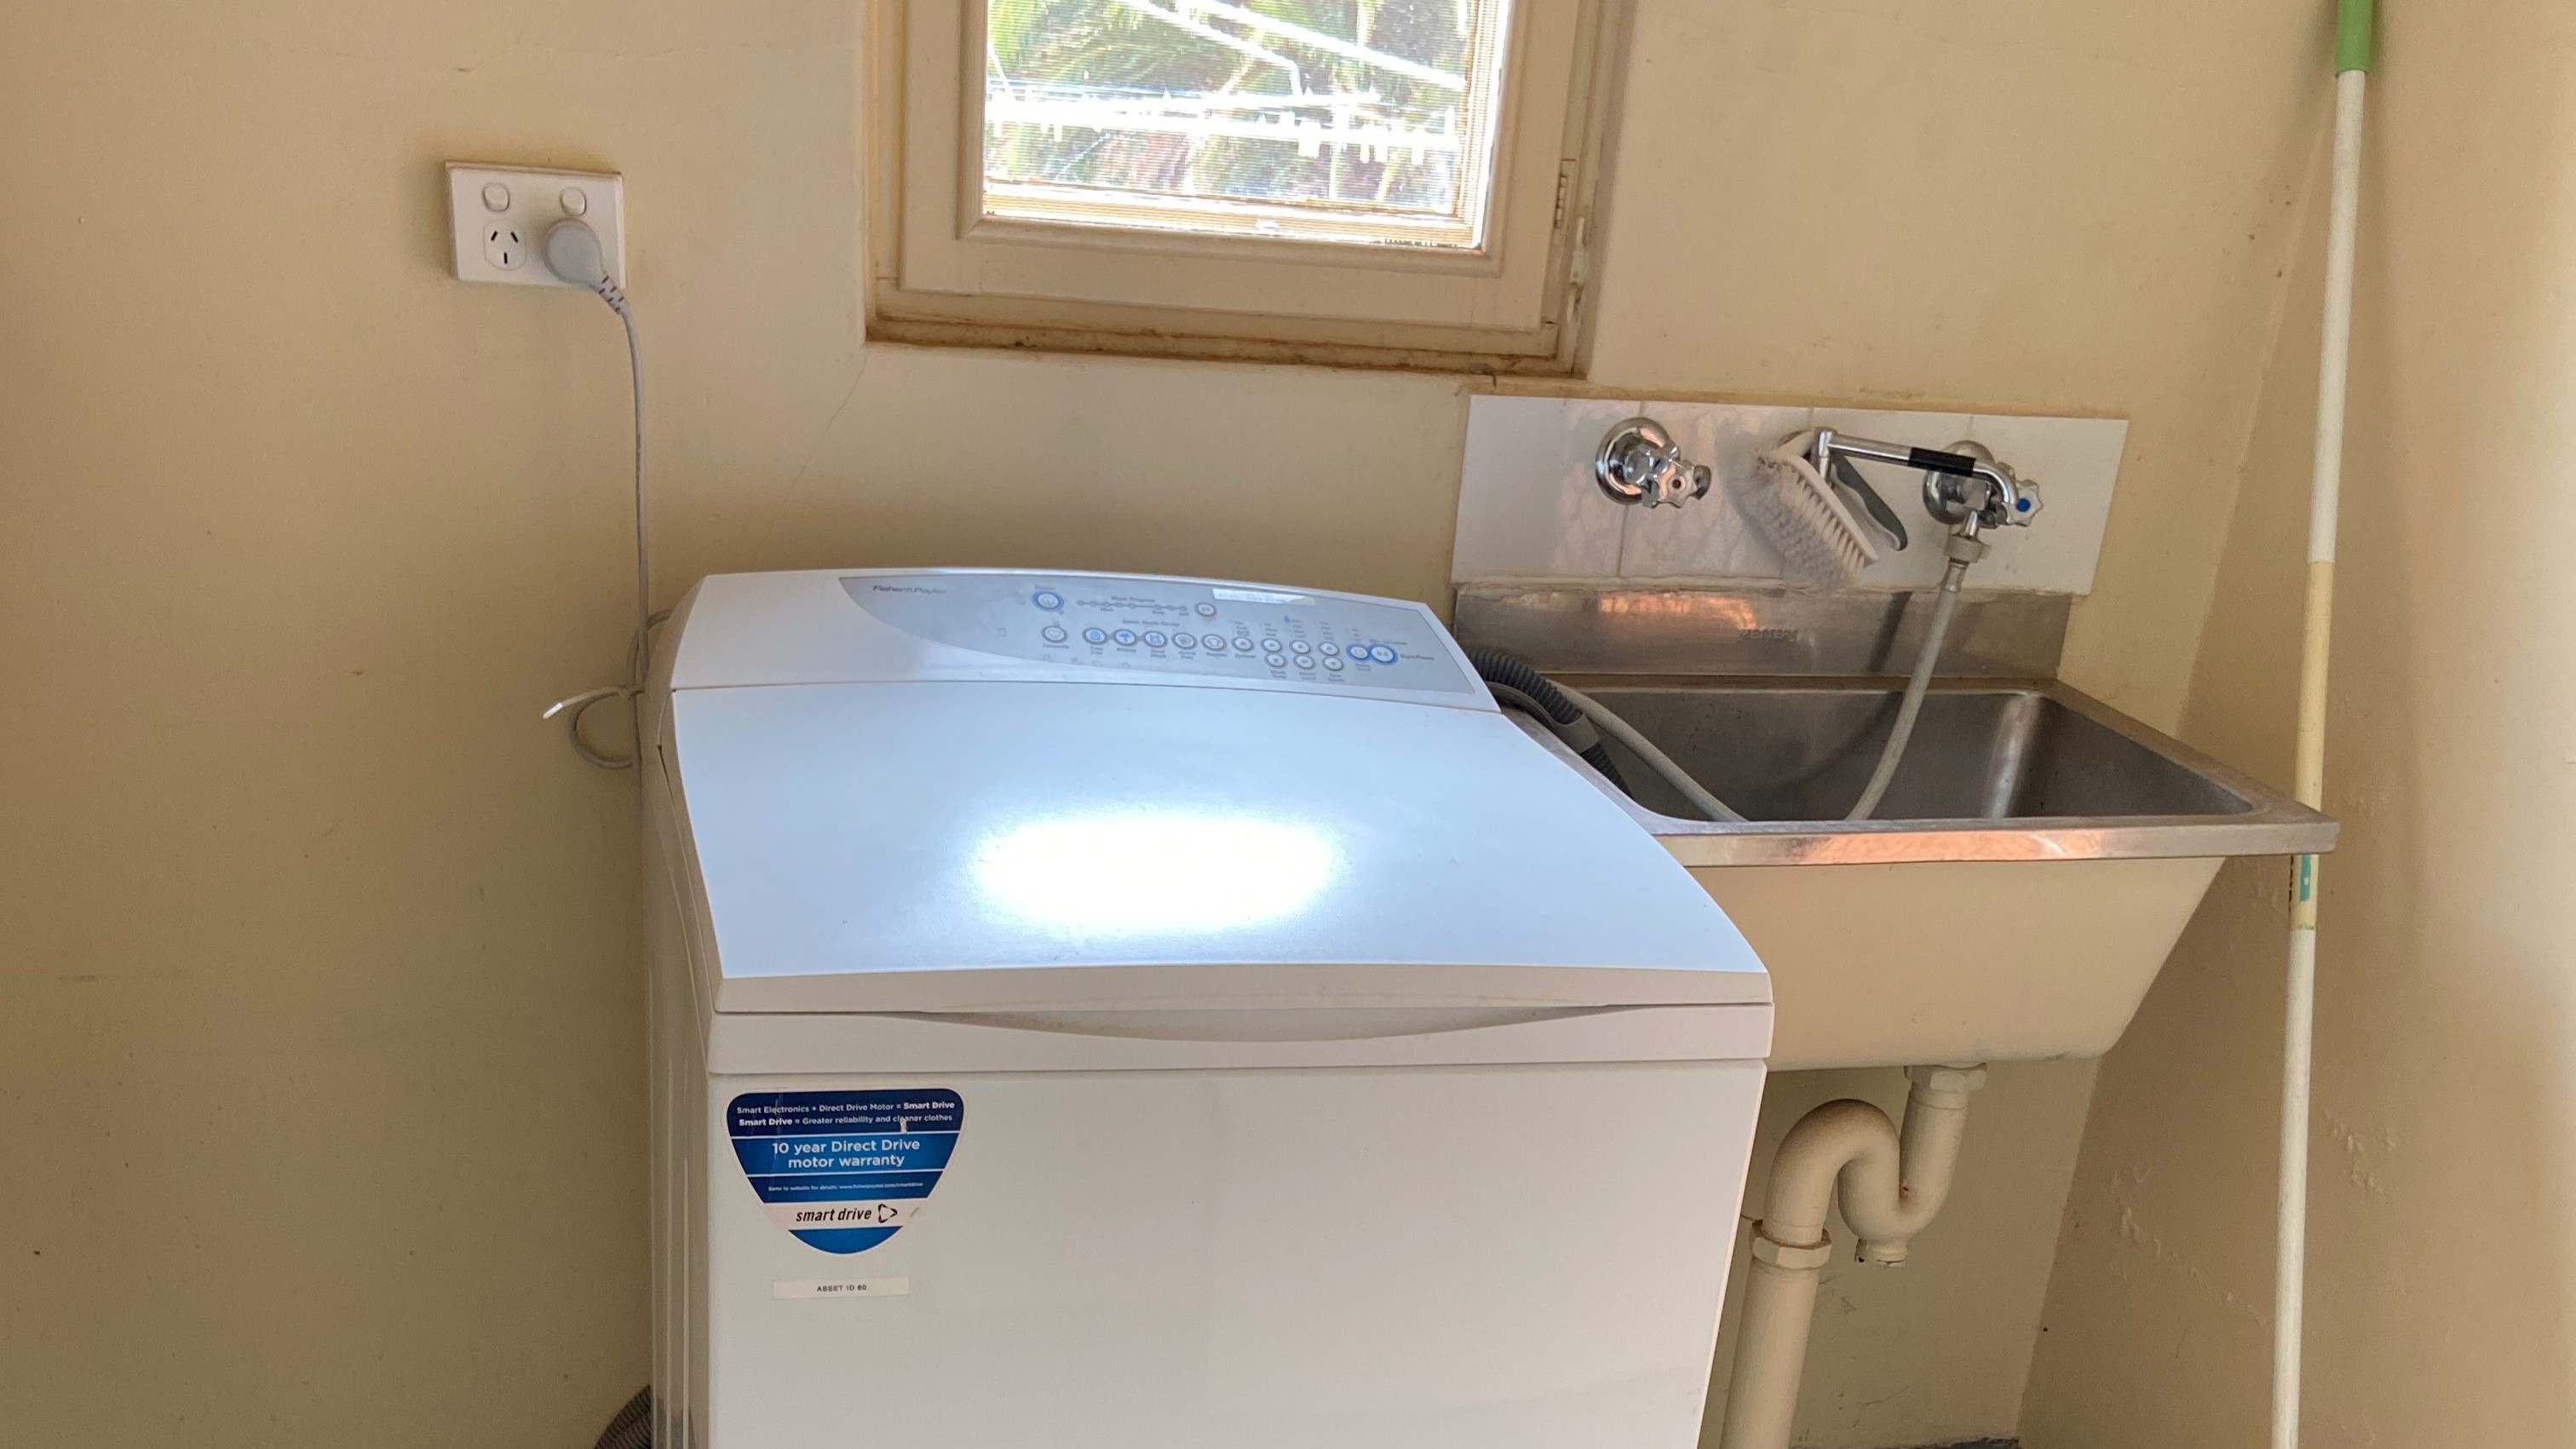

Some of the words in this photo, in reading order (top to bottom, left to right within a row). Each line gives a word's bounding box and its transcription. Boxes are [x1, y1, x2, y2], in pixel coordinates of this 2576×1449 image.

[763, 1105, 810, 1114] Electronics
[819, 1104, 844, 1113] Direct
[846, 1103, 868, 1112] Drive
[903, 1101, 930, 1110] Smart
[932, 1101, 955, 1109] Drive
[739, 1118, 767, 1127] Smart
[802, 1117, 833, 1125] Greater
[835, 1115, 873, 1124] reliability
[923, 1113, 953, 1122] clothes
[772, 1143, 790, 1154] 10
[793, 1141, 827, 1155] year
[831, 1139, 877, 1153] Direct
[881, 1137, 921, 1152] Drive
[788, 1156, 835, 1169] motor
[838, 1154, 906, 1168] warranty
[796, 1209, 836, 1222] smart
[837, 1207, 872, 1222] drive
